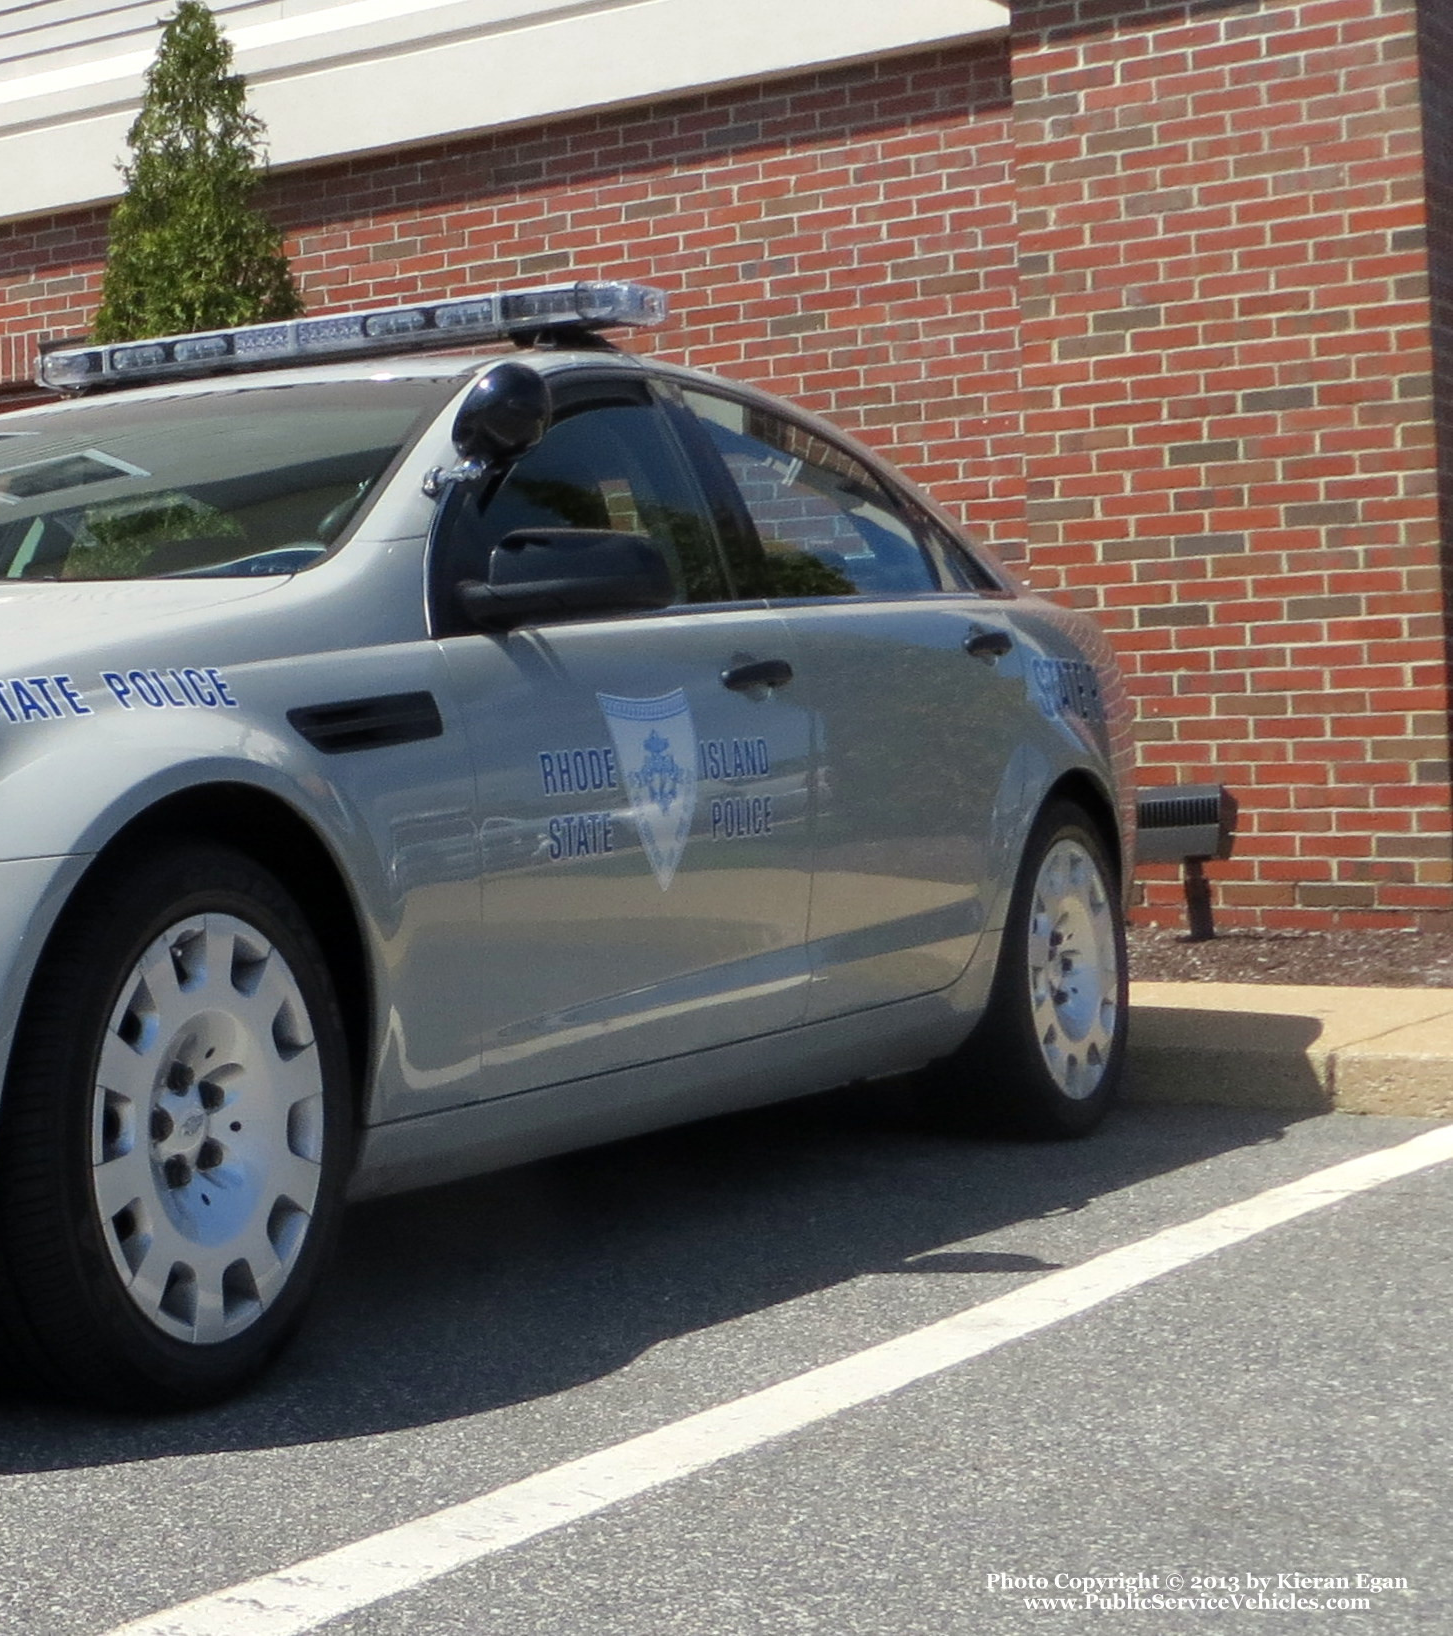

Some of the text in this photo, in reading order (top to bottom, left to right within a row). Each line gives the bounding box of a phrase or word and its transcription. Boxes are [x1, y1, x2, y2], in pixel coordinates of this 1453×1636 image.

[100, 668, 242, 710] POLICE
[538, 737, 771, 797] RHODE ISLAND
[548, 797, 773, 862] STATE POLICE
